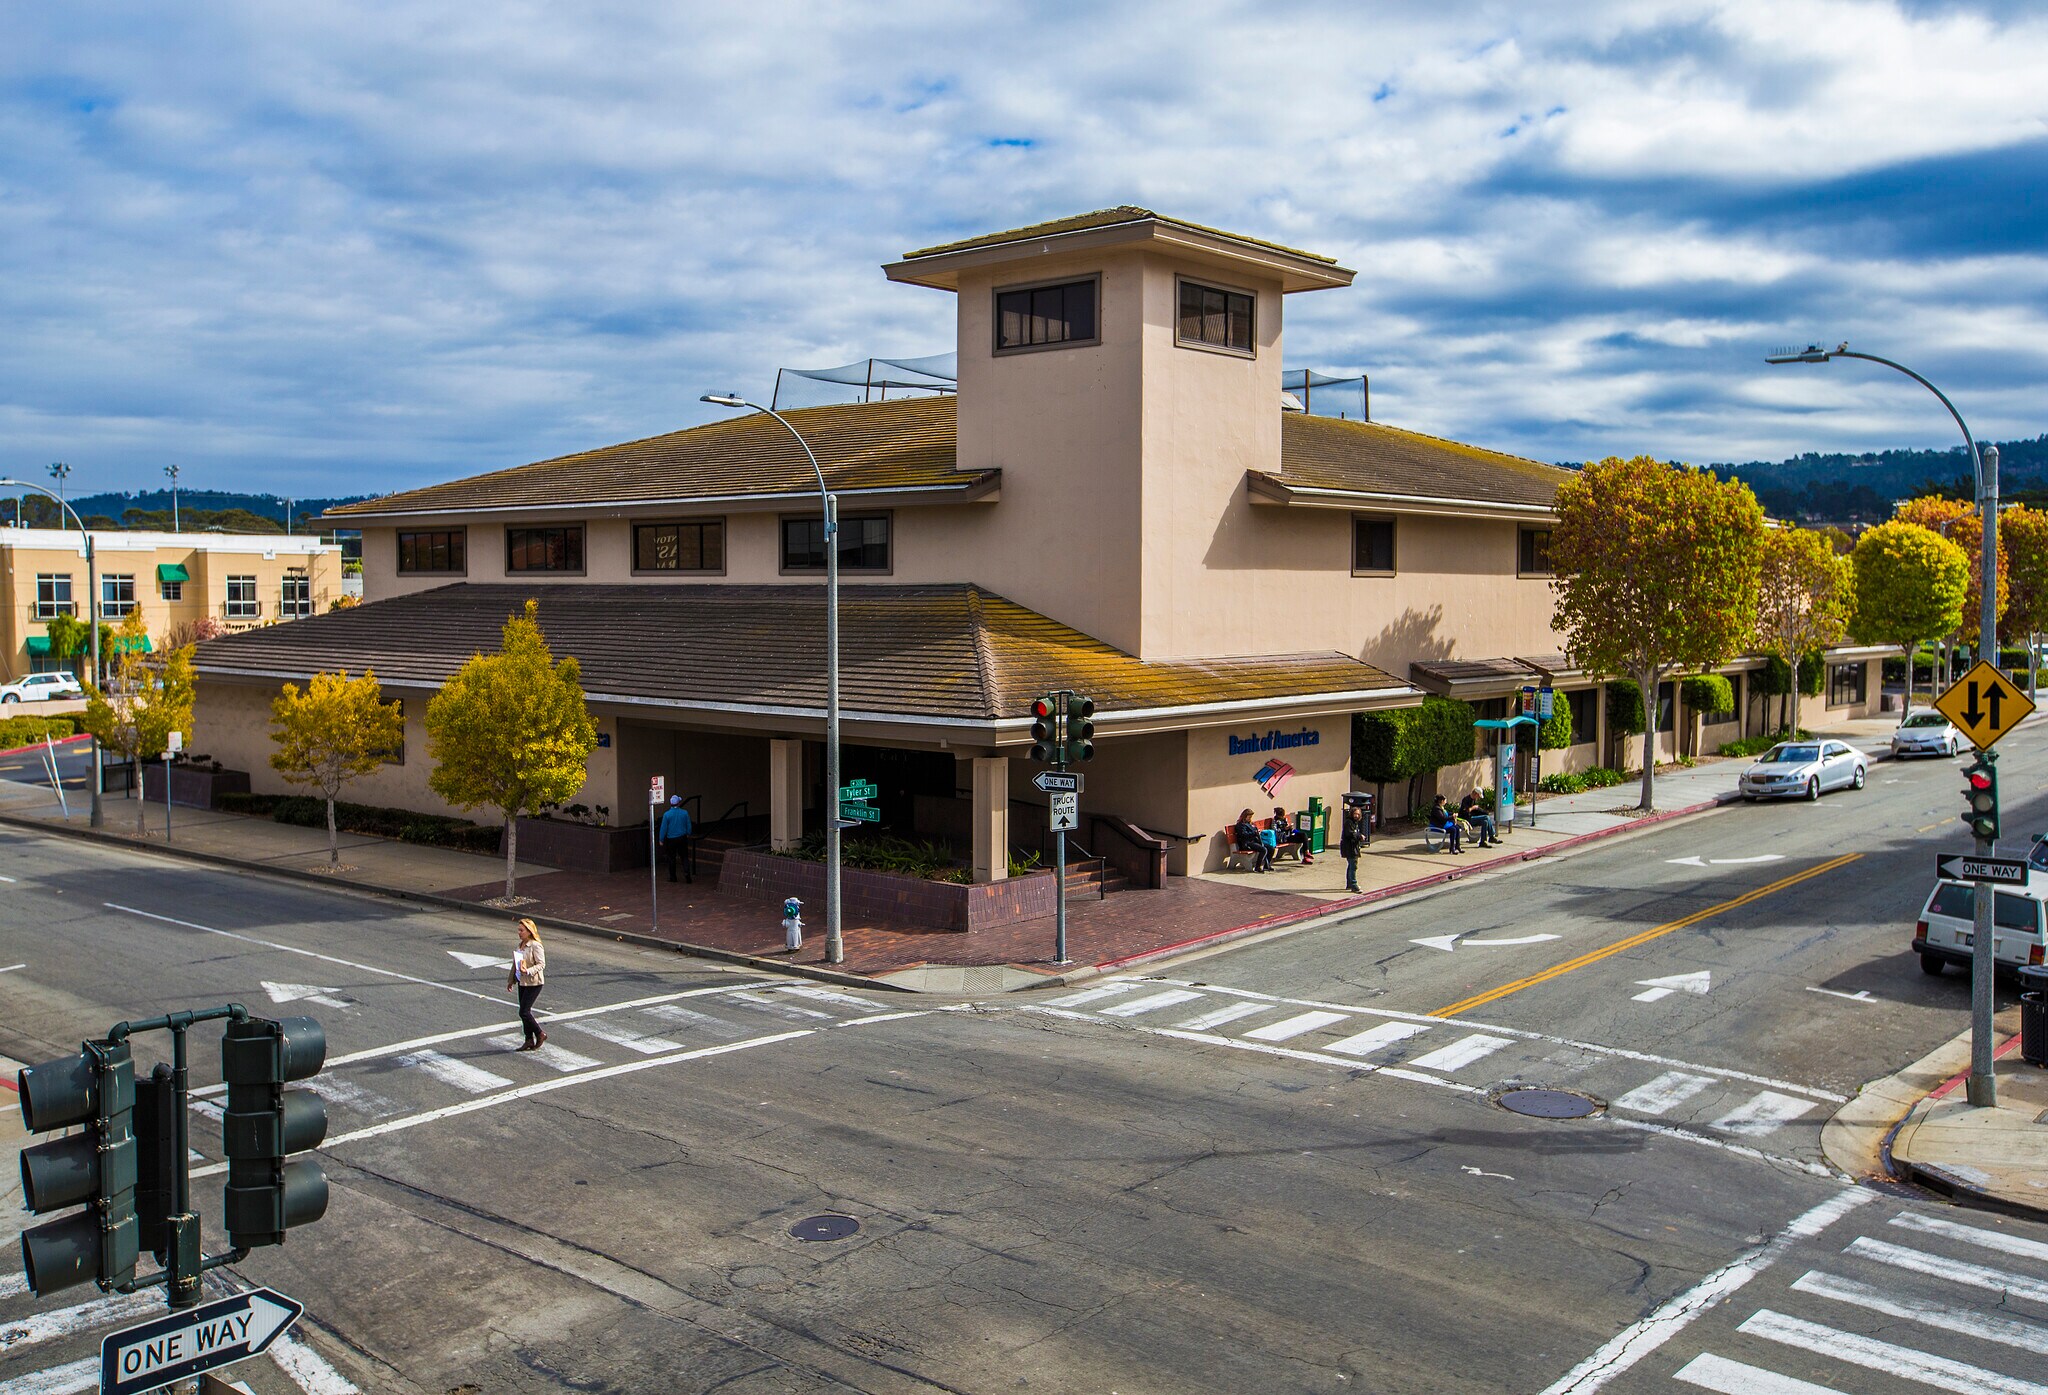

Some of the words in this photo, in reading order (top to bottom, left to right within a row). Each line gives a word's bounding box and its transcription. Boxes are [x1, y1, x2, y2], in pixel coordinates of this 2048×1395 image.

[1229, 733, 1260, 756] Bank
[1260, 731, 1274, 751] of
[1273, 726, 1320, 750] America
[1044, 777, 1058, 786] ONE
[1060, 778, 1074, 788] WAY
[846, 788, 862, 798] Tyler
[863, 787, 871, 795] St
[1053, 795, 1075, 806] TRUCK
[844, 807, 868, 818] Franklin
[868, 810, 875, 819] St
[1053, 806, 1075, 816] ROUTE
[1963, 863, 1987, 875] ONE
[1992, 866, 2018, 878] WAY
[124, 1333, 183, 1375] ONE
[195, 1312, 254, 1352] WAY
